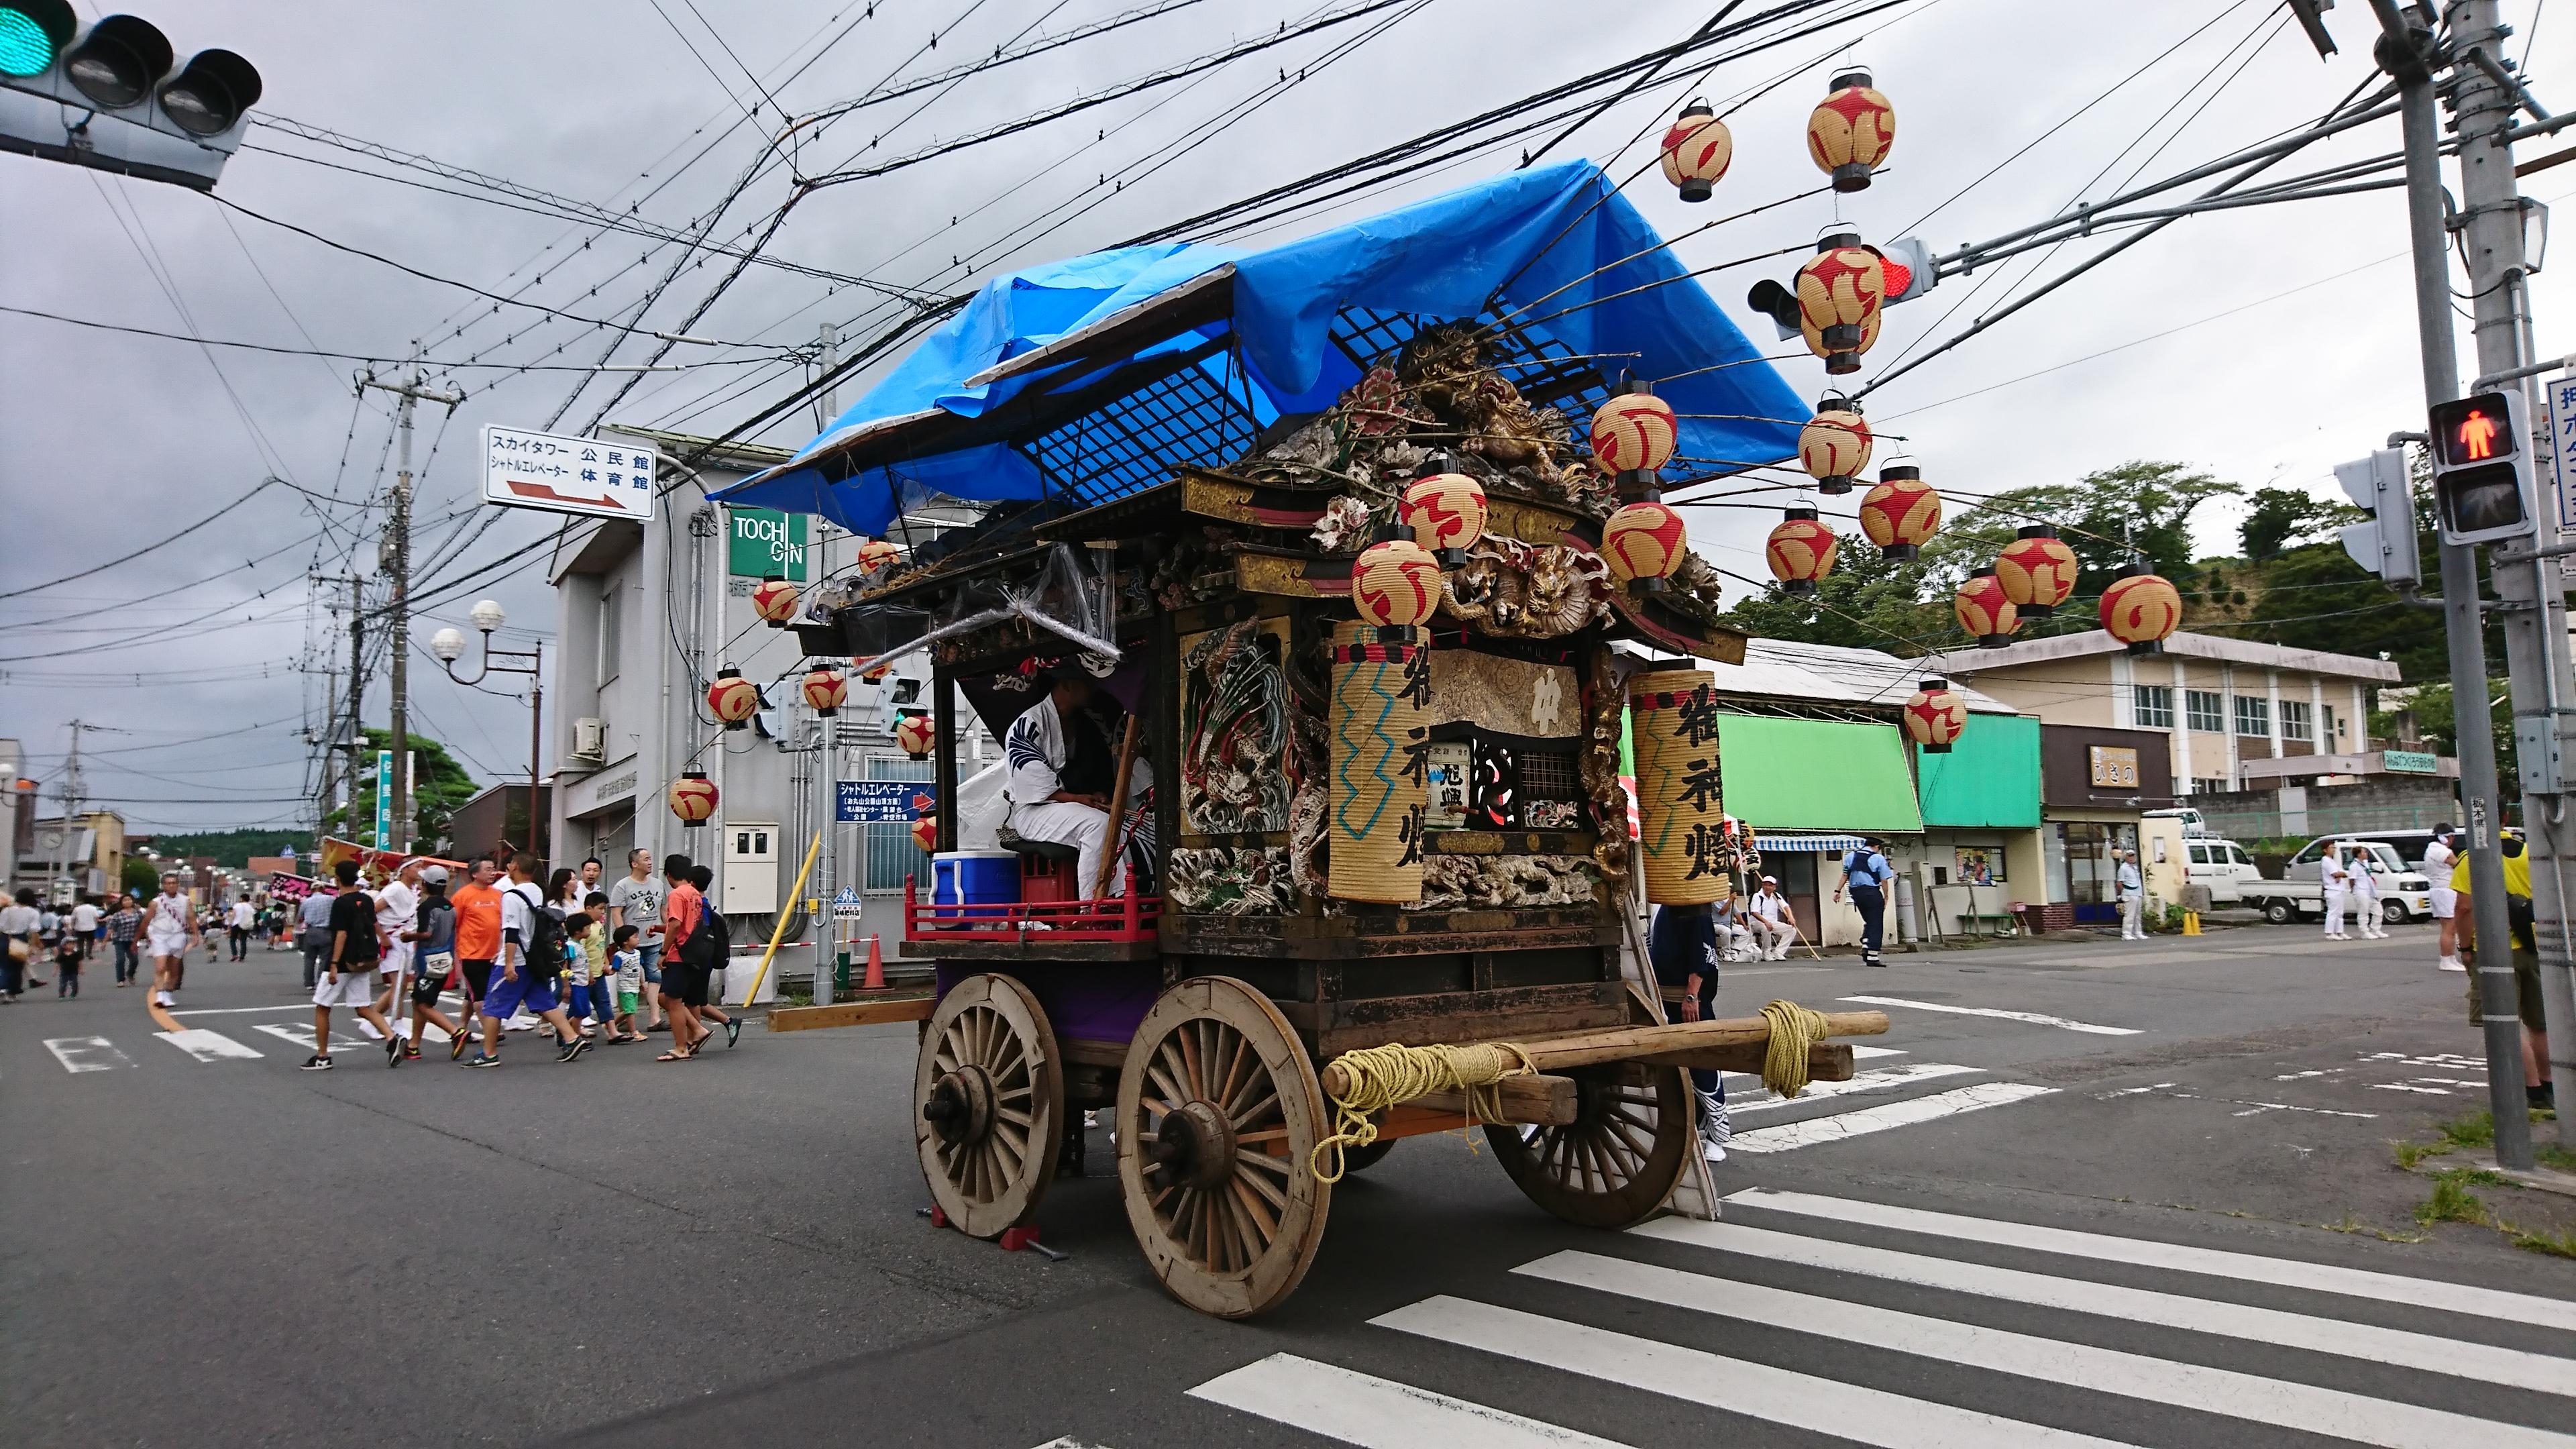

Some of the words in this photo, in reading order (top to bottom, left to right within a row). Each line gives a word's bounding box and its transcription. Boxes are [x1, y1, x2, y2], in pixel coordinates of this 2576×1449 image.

[493, 436, 569, 455] スカイタワー
[492, 456, 569, 477] シャトルエレベーター
[581, 448, 649, 470] 公民館
[581, 468, 649, 490] 体育館
[841, 784, 911, 796] シャトルエレベーター
